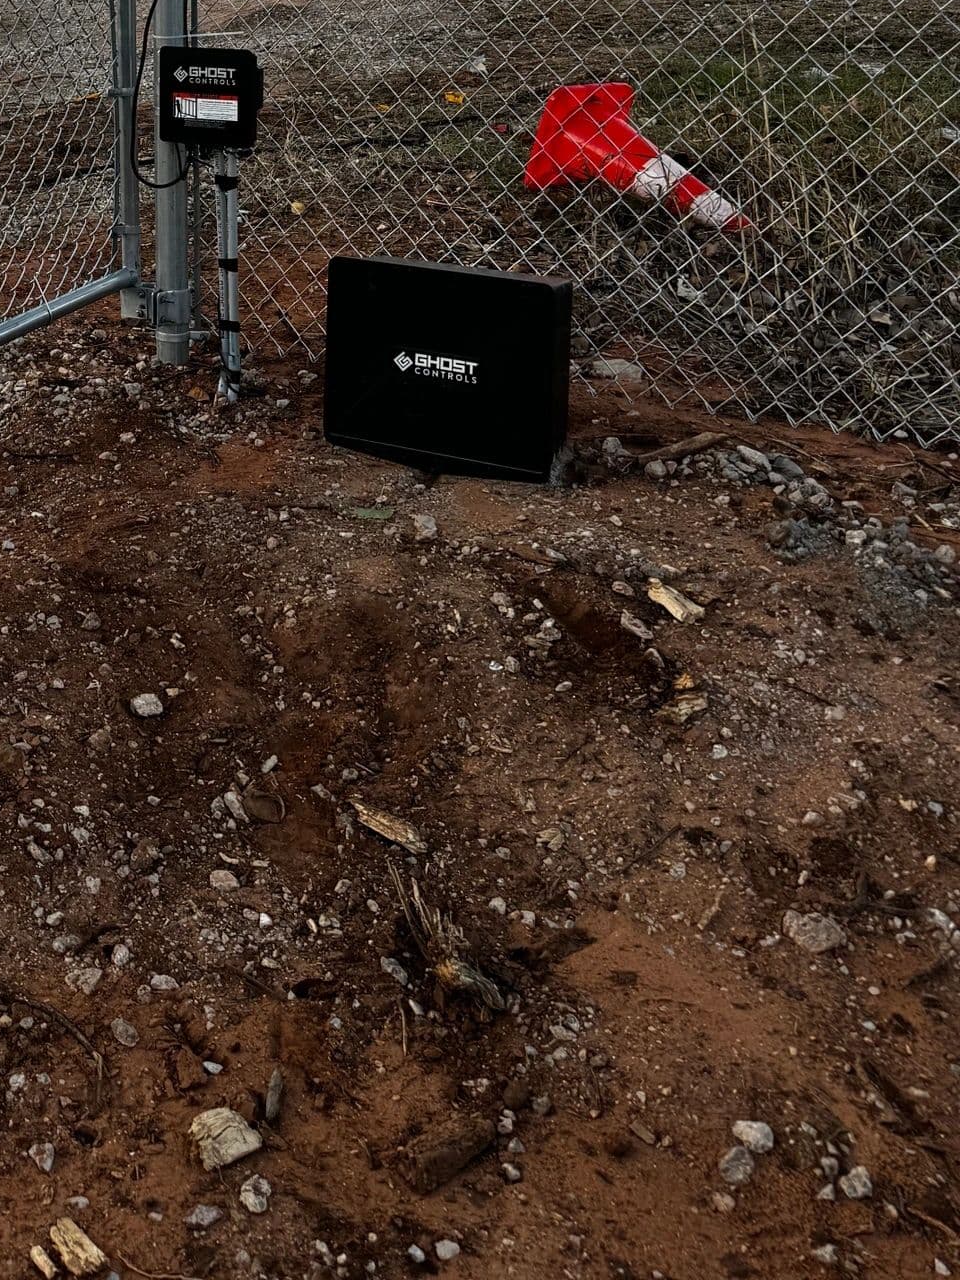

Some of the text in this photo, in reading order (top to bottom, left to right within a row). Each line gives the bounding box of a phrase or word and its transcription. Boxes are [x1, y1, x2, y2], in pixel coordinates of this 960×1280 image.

[189, 66, 236, 78] GHOST
[189, 78, 236, 86] CONTROLS
[414, 353, 479, 375] GHOST
[414, 367, 477, 384] CONTROLS
